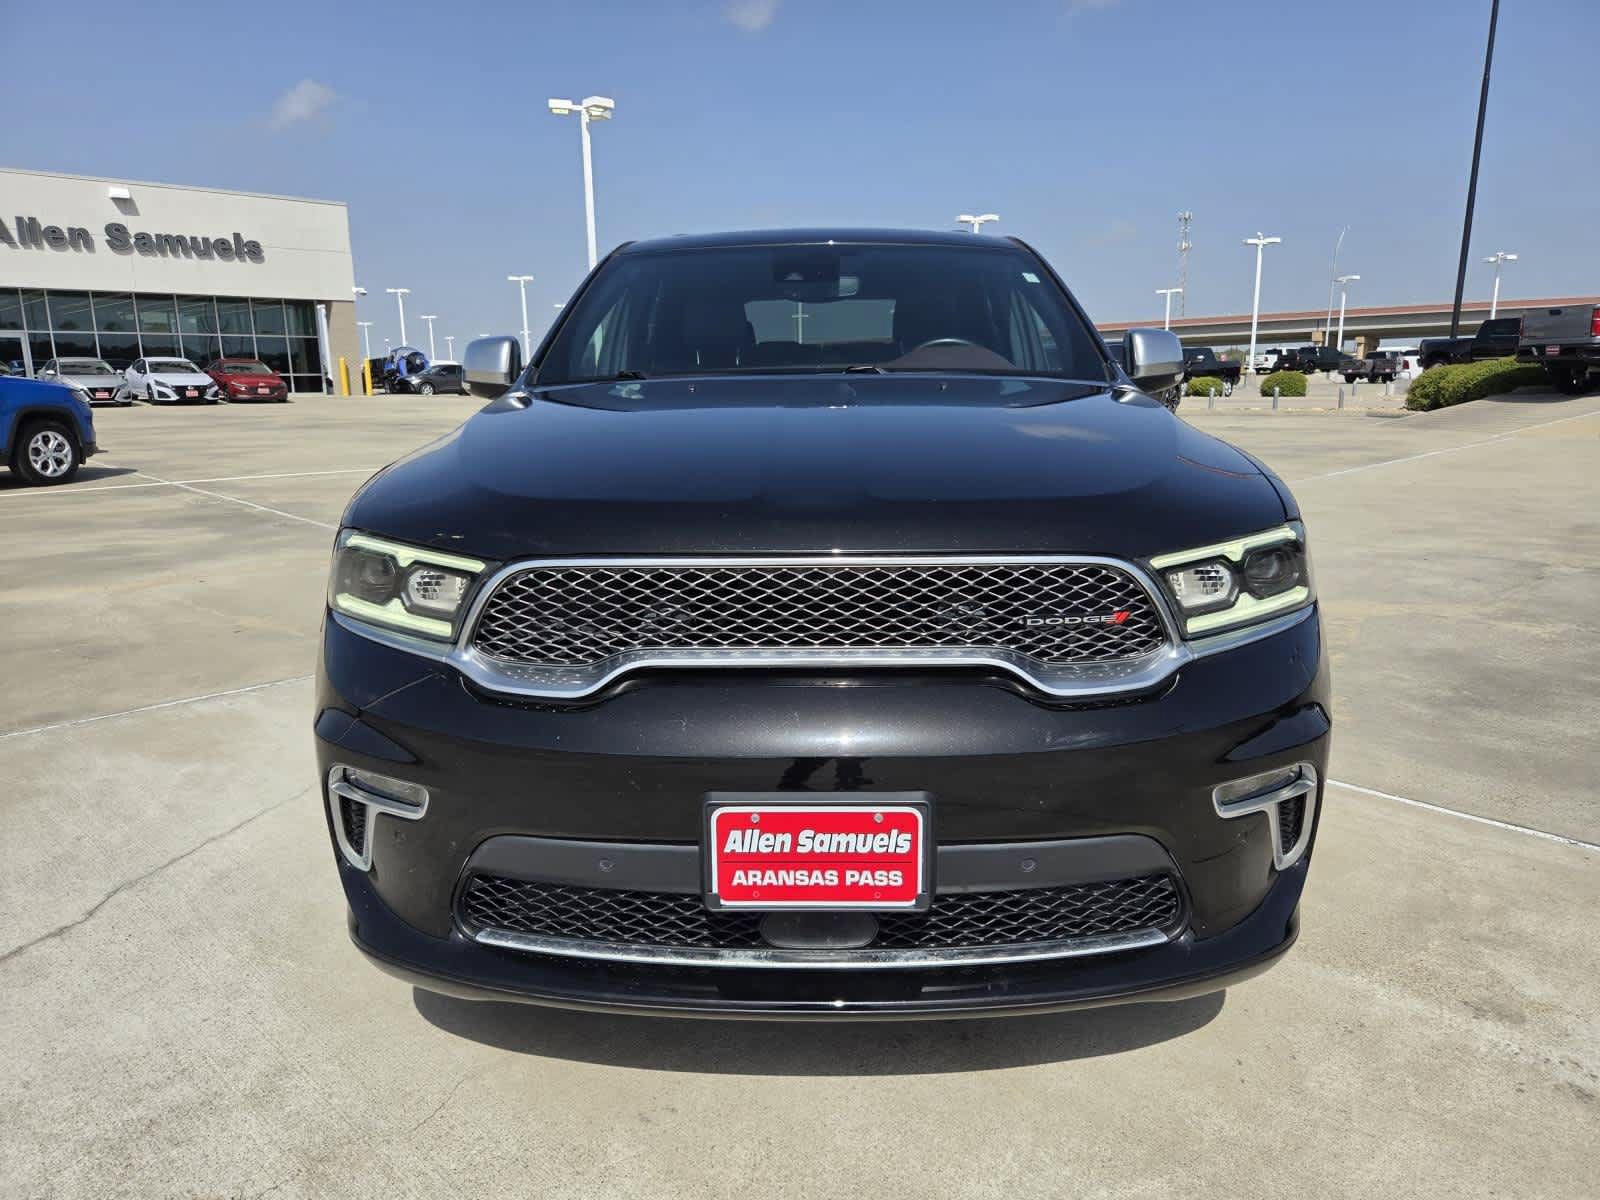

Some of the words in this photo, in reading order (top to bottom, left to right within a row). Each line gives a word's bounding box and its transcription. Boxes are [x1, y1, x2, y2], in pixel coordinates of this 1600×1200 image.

[105, 223, 264, 262] Samuels
[1026, 615, 1116, 626] DODGE
[723, 829, 792, 853] Allen
[796, 829, 912, 854] Samuels
[731, 870, 839, 887] ARANSAS
[845, 870, 903, 887] PASS
